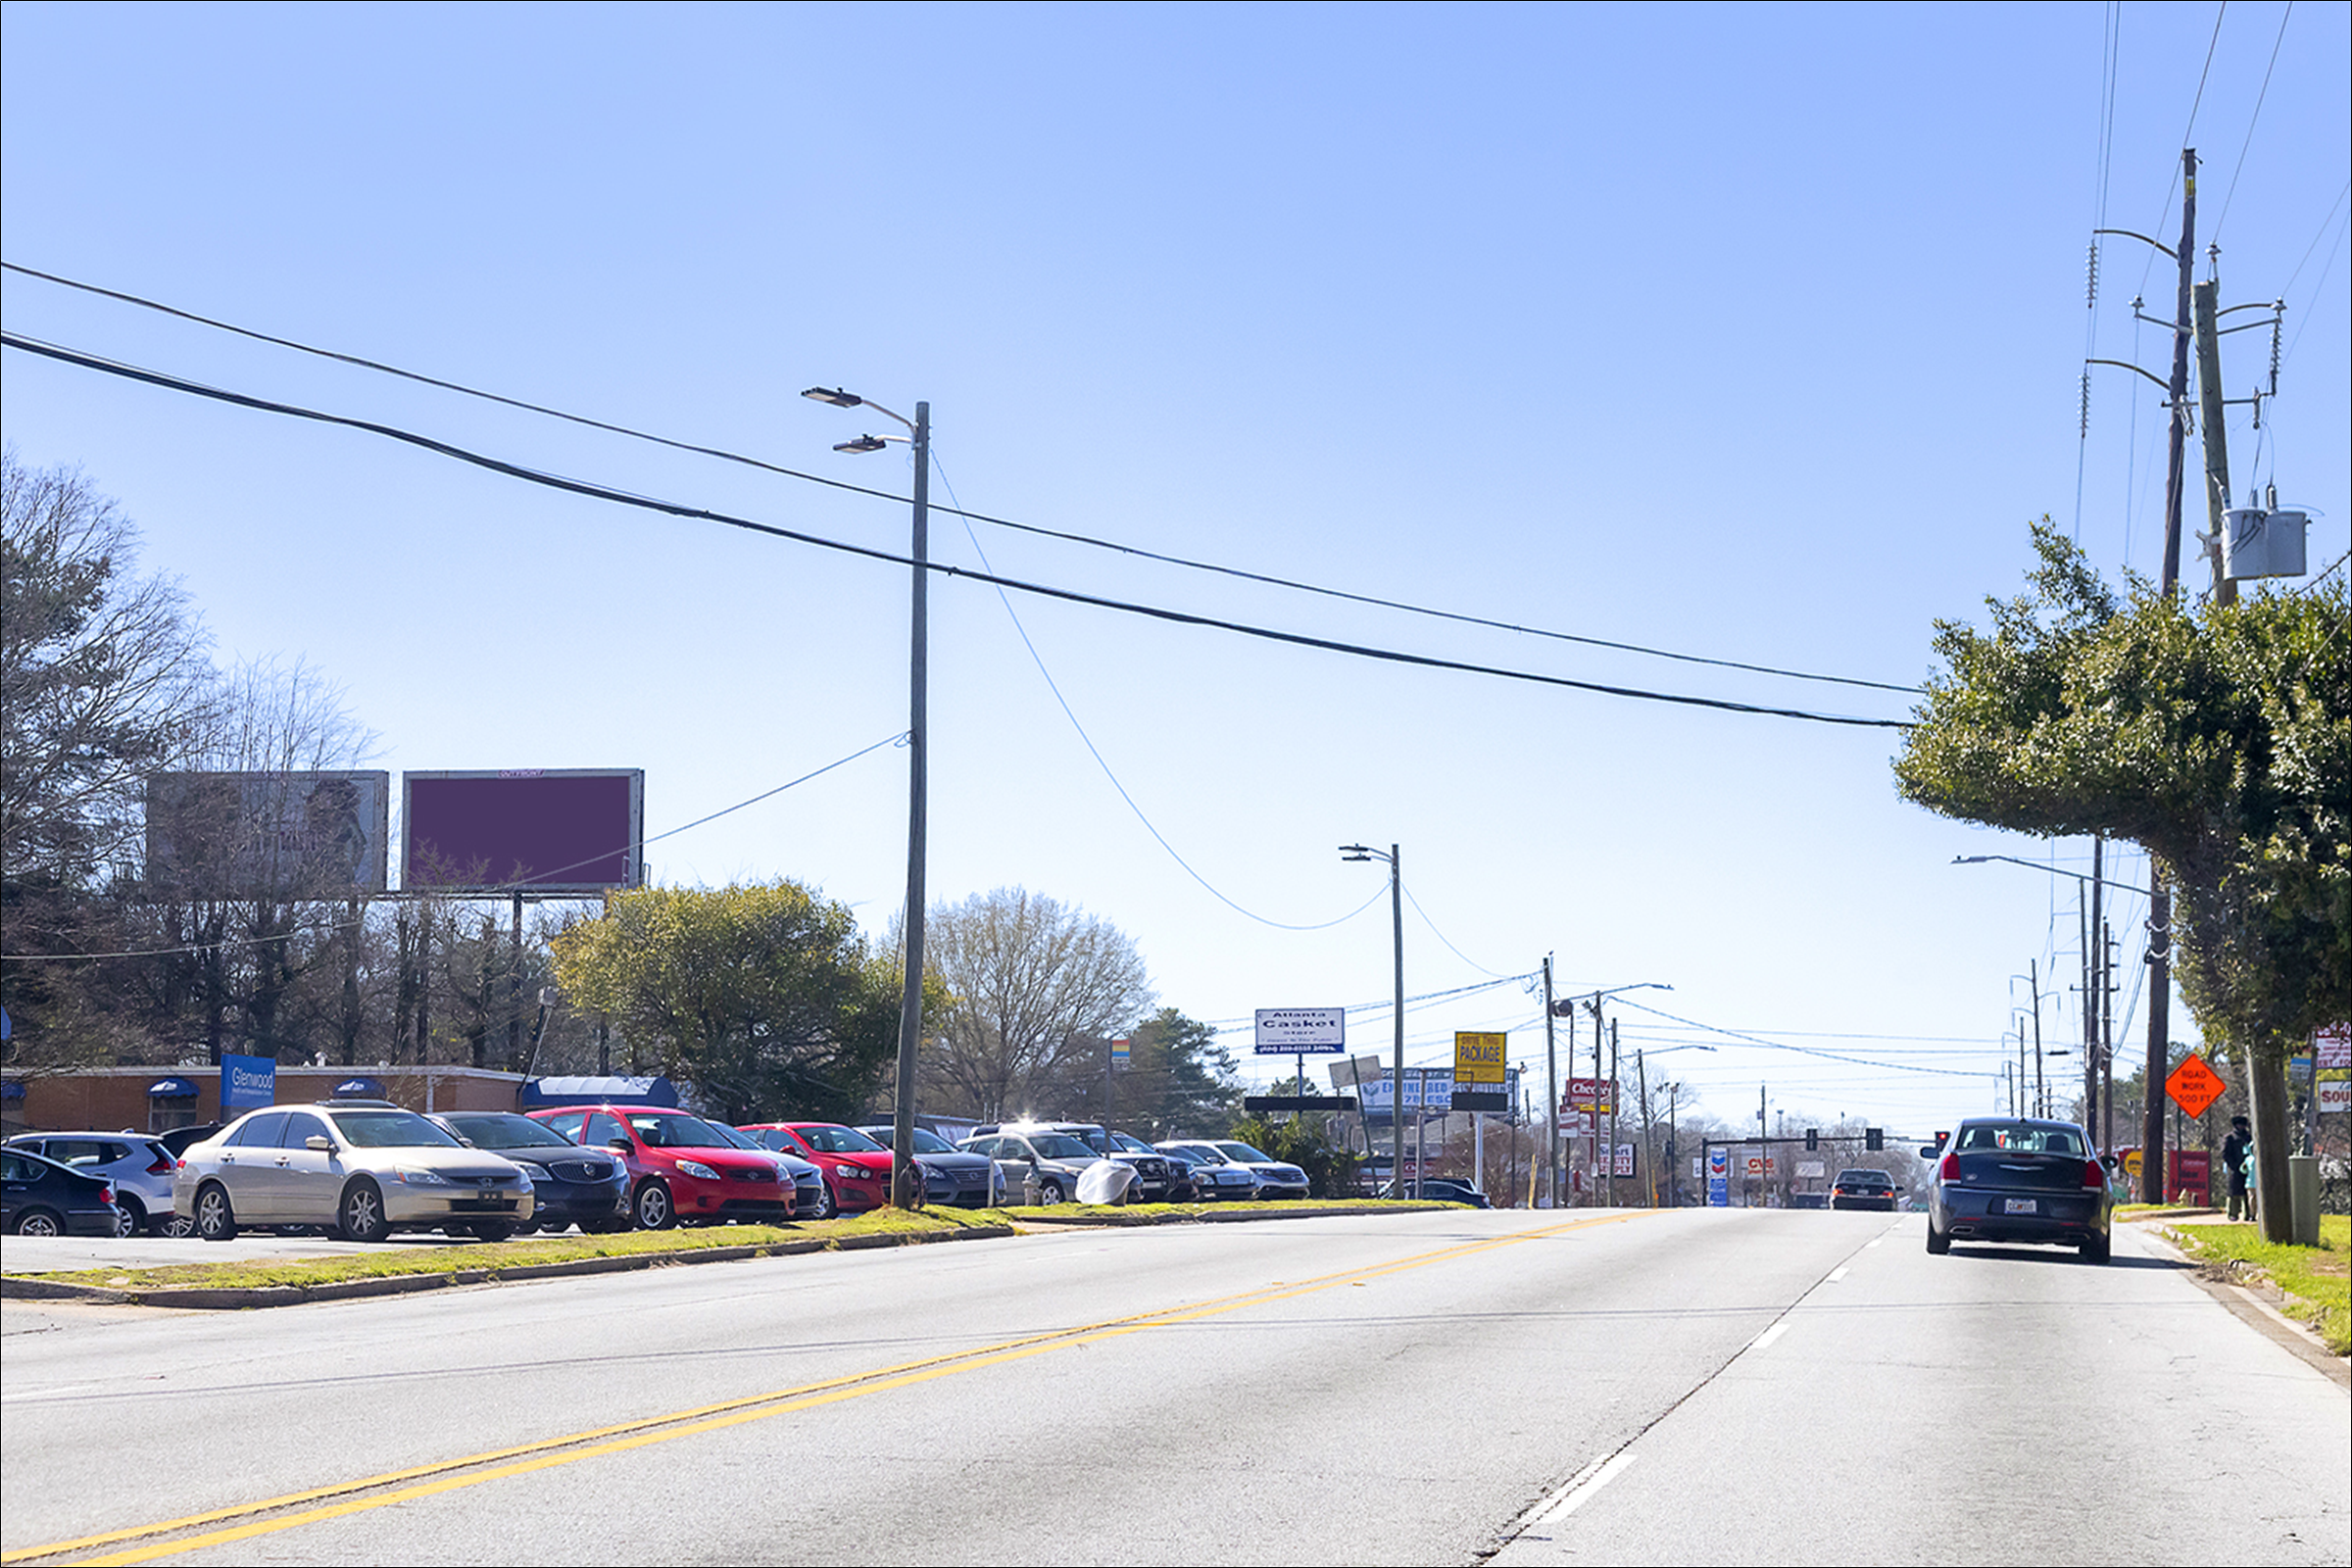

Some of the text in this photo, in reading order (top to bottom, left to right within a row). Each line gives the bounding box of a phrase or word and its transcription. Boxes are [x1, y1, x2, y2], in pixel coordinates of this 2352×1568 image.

[1262, 1019, 1336, 1028] Casket
[1460, 1046, 1500, 1062] PACKAGE
[232, 1067, 273, 1089] Glenwood
[2181, 1070, 2207, 1079] ROAD
[1382, 1082, 1447, 1093] ENINERED
[2179, 1094, 2198, 1102] 500
[2321, 1090, 2351, 1103] SOU
[1598, 1146, 1629, 1155] Sart
[1748, 1157, 1774, 1168] CVS
